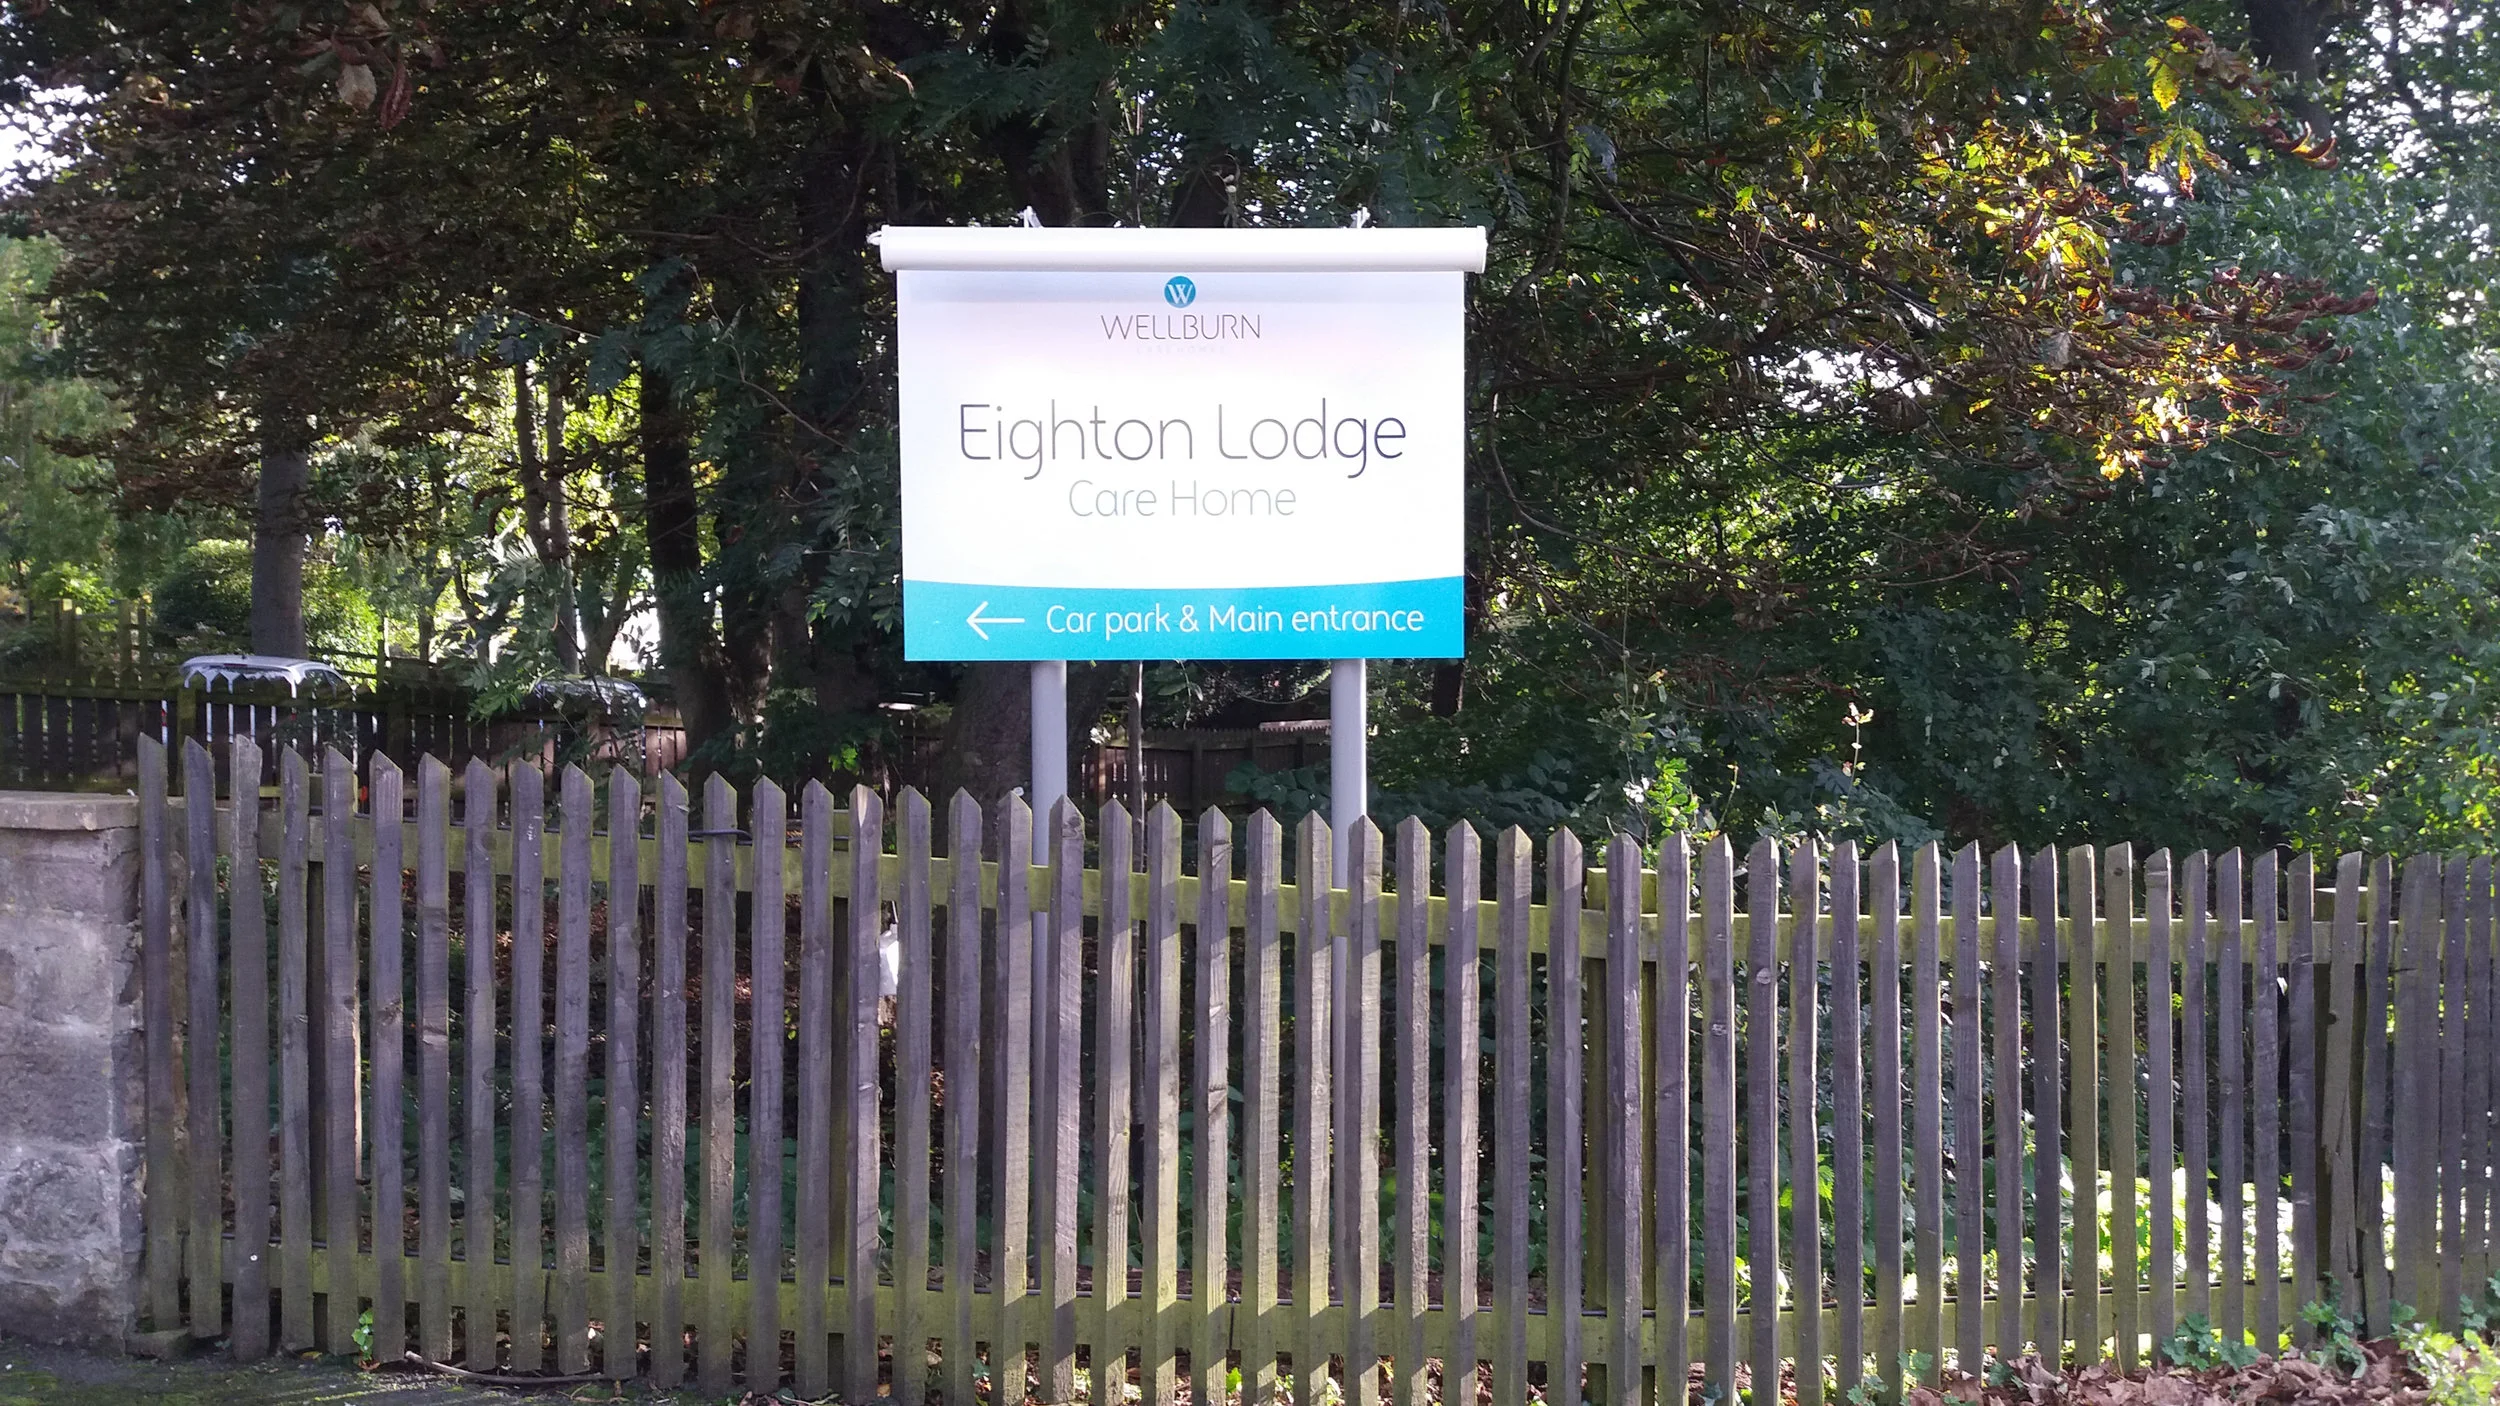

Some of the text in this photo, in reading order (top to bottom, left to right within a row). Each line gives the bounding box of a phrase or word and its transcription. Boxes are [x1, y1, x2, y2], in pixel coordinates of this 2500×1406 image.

[1166, 282, 1194, 306] W
[1100, 314, 1261, 340] WELLBURN
[960, 397, 1407, 481] Eighton Lodge
[1068, 479, 1297, 517] Care Home
[1045, 602, 1425, 642] Car park & Main entrance
